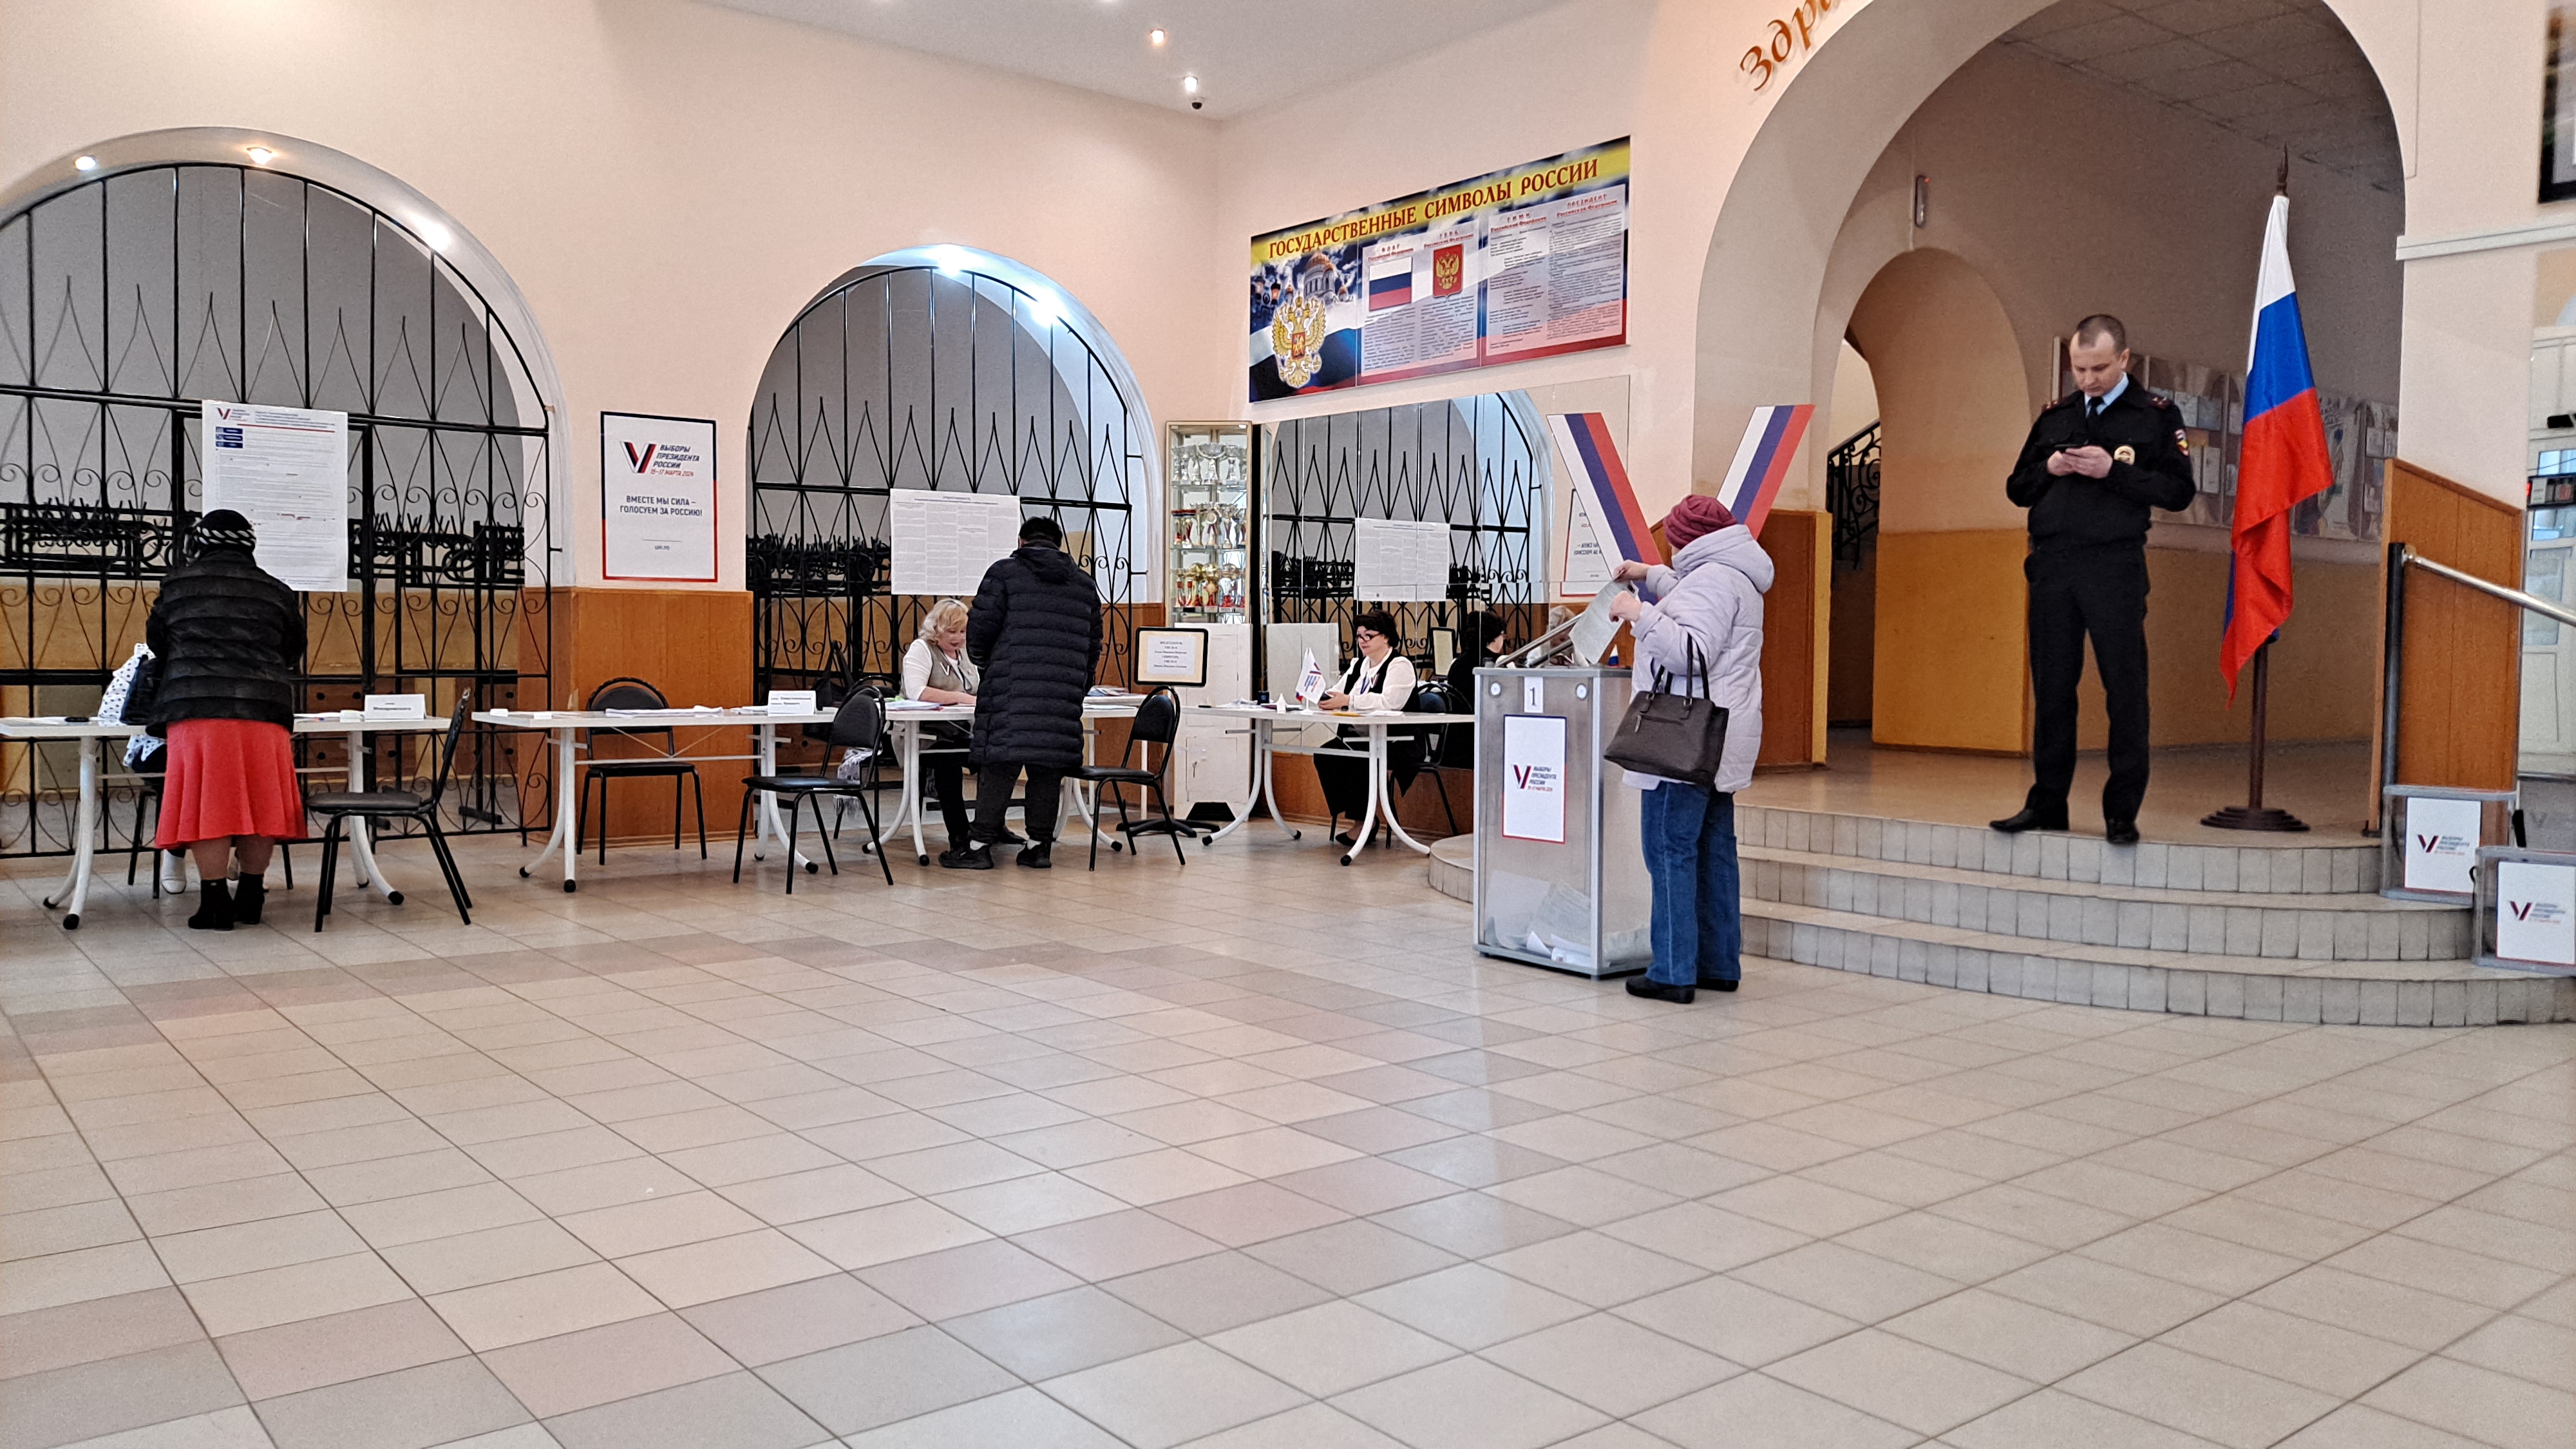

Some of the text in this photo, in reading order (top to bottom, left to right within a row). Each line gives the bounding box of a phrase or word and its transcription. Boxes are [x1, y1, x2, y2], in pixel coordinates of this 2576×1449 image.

[1739, 0, 1832, 91] Здр
[1269, 158, 1598, 258] ГОСУДАРСТВЕННЫЕ СИМВОЛЫ РОССИИ
[659, 444, 691, 453] ВЫБОРЫ
[656, 453, 700, 462] ПРЕЗИДЕНТА
[652, 460, 681, 469] РОССИИ
[626, 495, 655, 504] ВМЕСТЕ
[620, 506, 658, 514] ГОЛОСУЕМ
[670, 508, 703, 516] РОССИЮ!
[1529, 687, 1537, 706] 1
